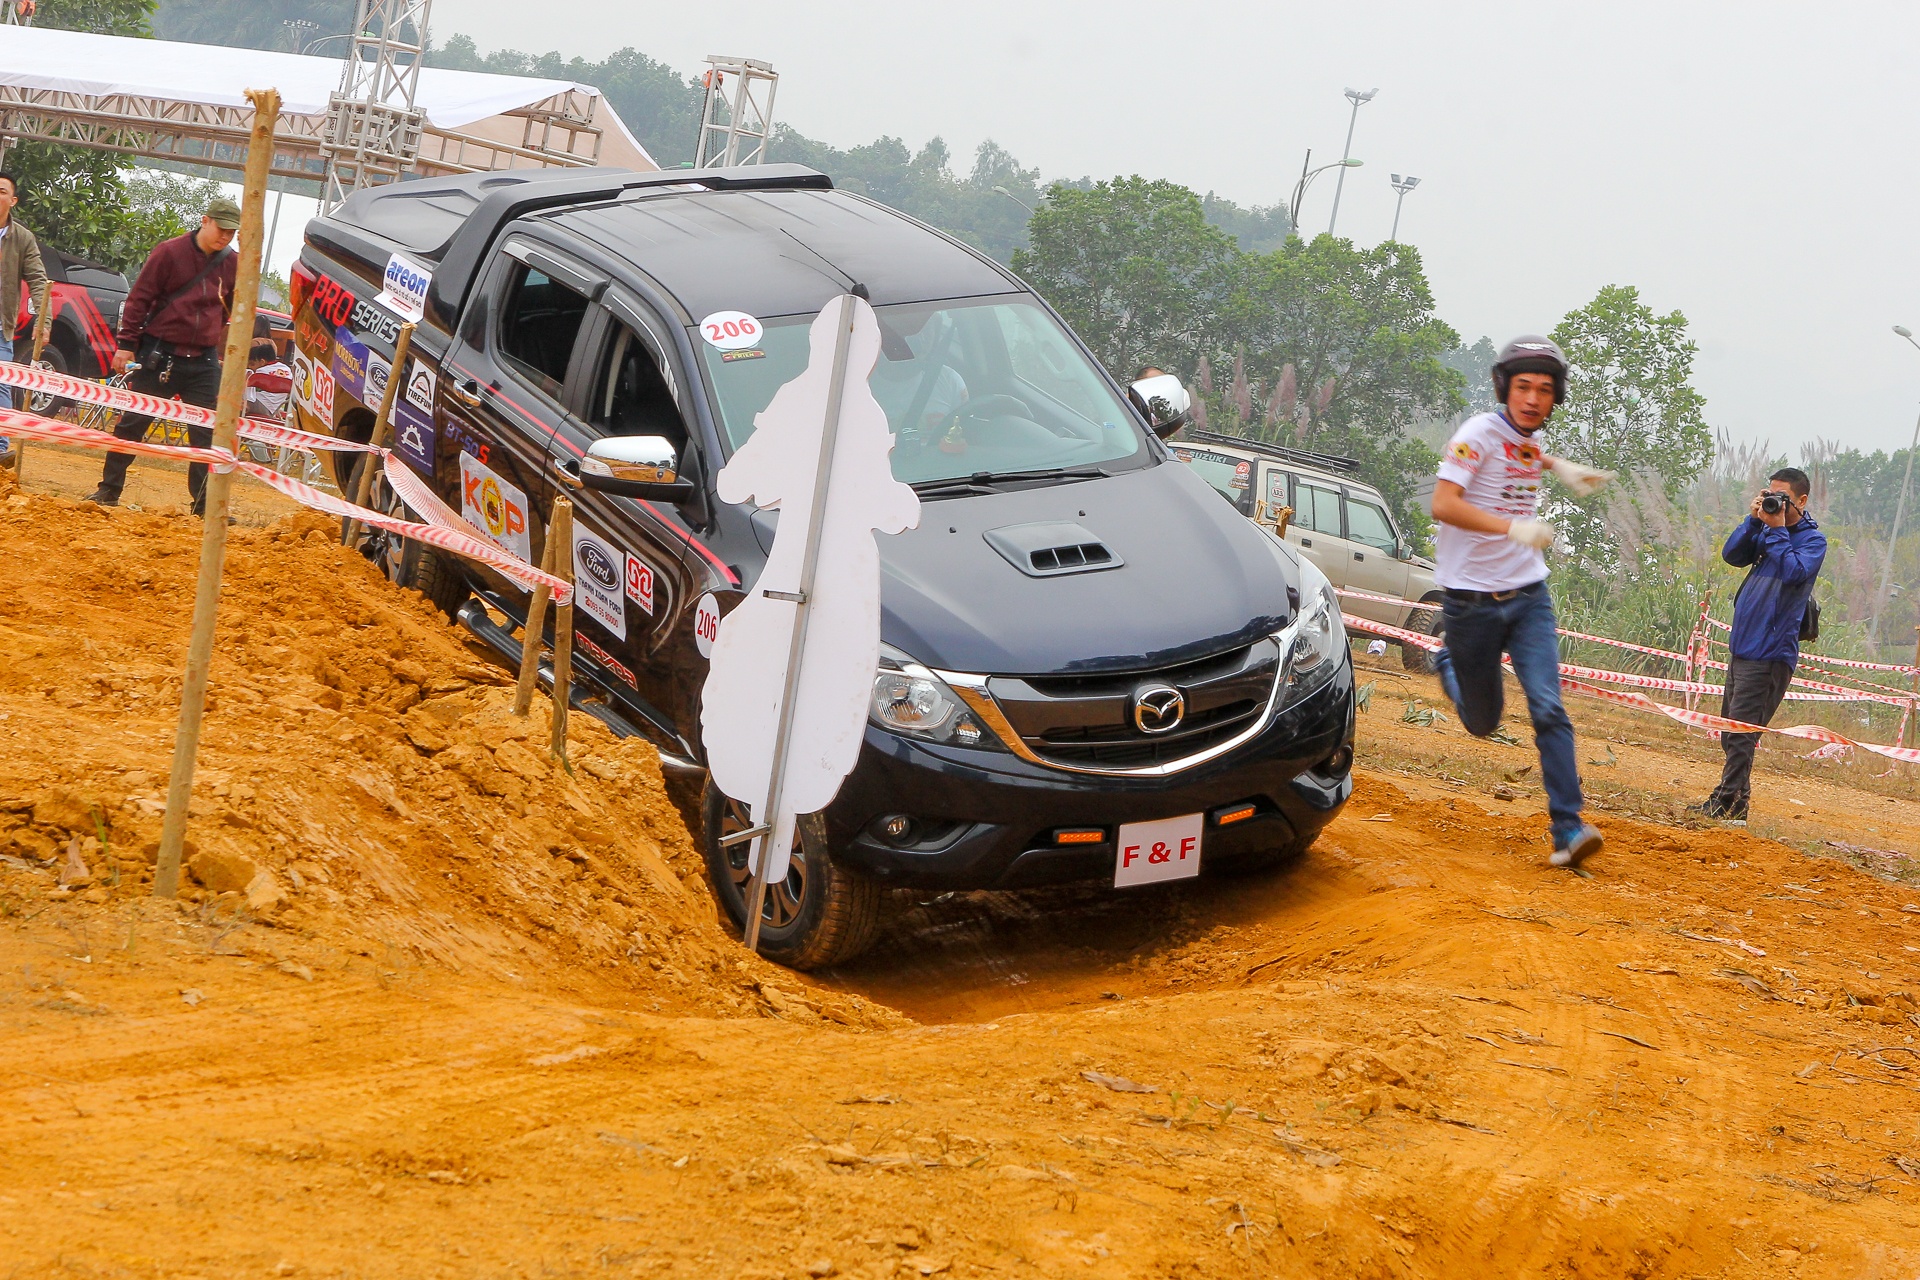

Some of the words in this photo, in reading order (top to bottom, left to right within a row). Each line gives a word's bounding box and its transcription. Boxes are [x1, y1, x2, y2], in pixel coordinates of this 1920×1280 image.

[386, 261, 427, 298] areon
[310, 274, 354, 327] PRO
[351, 301, 401, 344] SERIES
[706, 318, 756, 341] 206
[407, 387, 432, 412] TIREFUN
[1189, 451, 1228, 464] SUZUKI
[586, 549, 610, 582] Ford
[578, 576, 594, 596] THANH
[608, 599, 622, 616] FORD
[697, 609, 717, 643] 206
[1123, 846, 1140, 868] F
[1148, 841, 1170, 864] &
[1180, 836, 1196, 860] F
